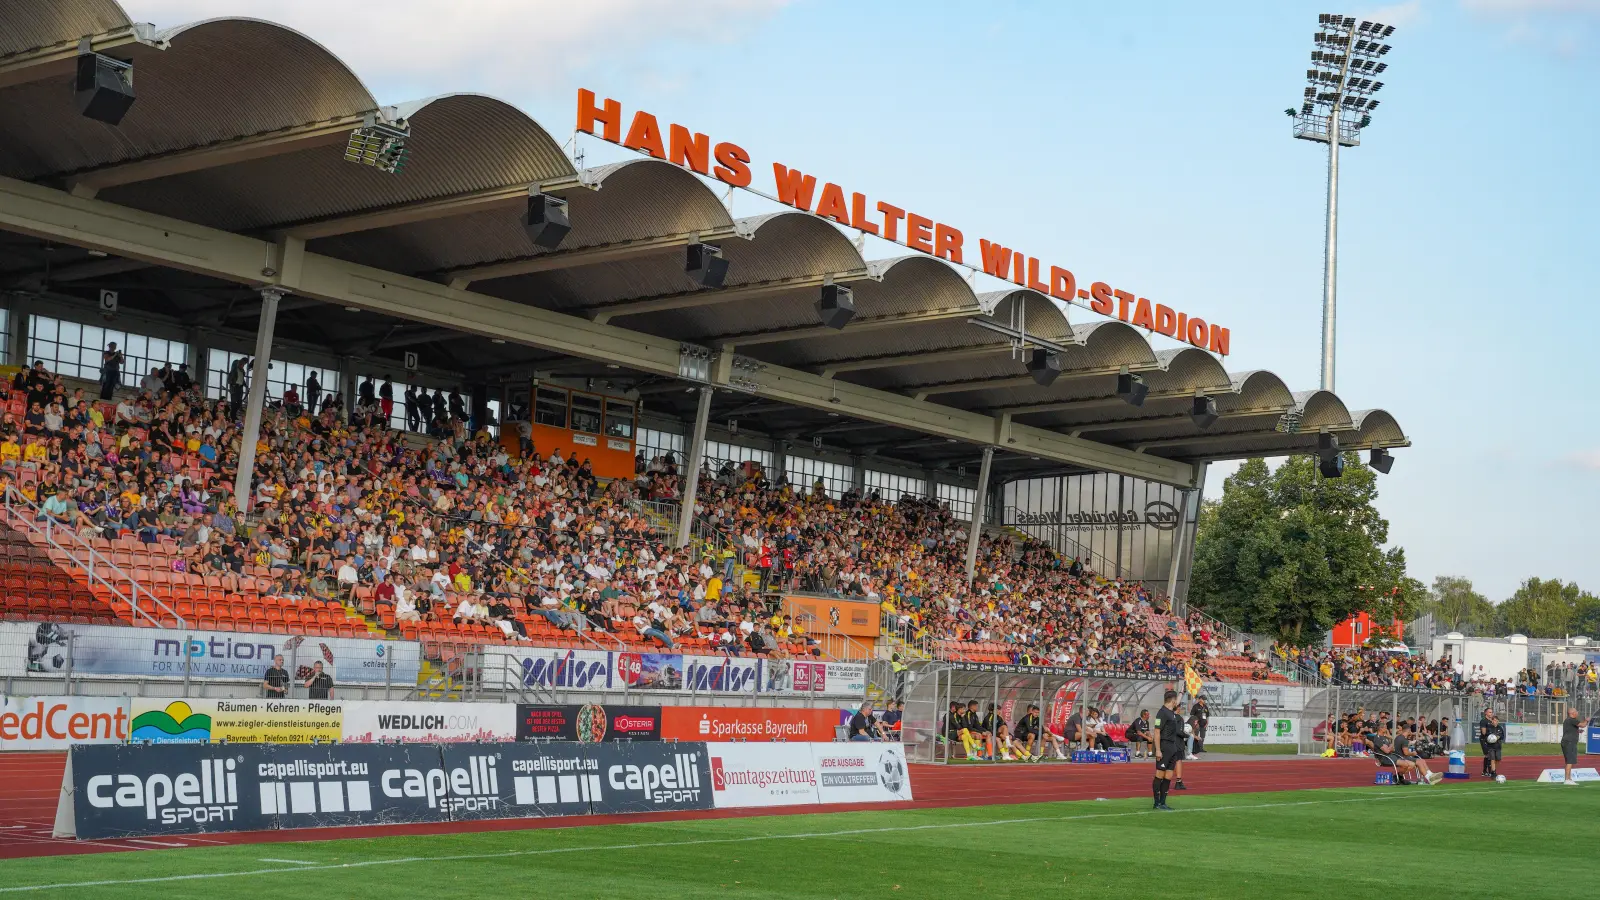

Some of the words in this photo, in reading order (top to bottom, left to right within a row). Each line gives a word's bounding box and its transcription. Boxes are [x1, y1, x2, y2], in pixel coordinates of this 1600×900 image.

[577, 88, 752, 188] HANS
[773, 162, 964, 265] WALTER
[980, 238, 1230, 356] WILD-STADION
[104, 293, 114, 308] C
[406, 353, 416, 369] D
[154, 635, 276, 661] motion
[153, 661, 172, 672] FOR
[206, 663, 226, 673] AND
[619, 658, 642, 674] 1948
[217, 701, 257, 713] Räumen
[266, 702, 300, 714] Kehren
[308, 703, 342, 717] Pflegen
[216, 719, 341, 731] www.ziegler-dienstleistungen.de
[378, 714, 478, 730] WEDLICH.COM
[711, 719, 763, 738] Sparkasse
[765, 718, 809, 737] Bayreuth
[226, 734, 258, 744] Bayreuth
[264, 735, 288, 743] Telefon
[288, 735, 304, 743] 0921
[258, 759, 369, 779] capellisport.eu
[512, 756, 599, 774] capellisport.eu
[820, 757, 837, 768] JEDE
[837, 757, 865, 768] AUSGABE
[381, 755, 499, 808] capelli
[608, 752, 700, 799] capelli
[715, 766, 817, 789] Sonntagszeitung
[823, 775, 833, 785] EIN
[834, 773, 877, 785] VOLLTREFFER!
[87, 758, 238, 820] capelli
[653, 789, 701, 804] SPORT
[439, 796, 500, 812] SPORT
[161, 805, 239, 824] SPORT
